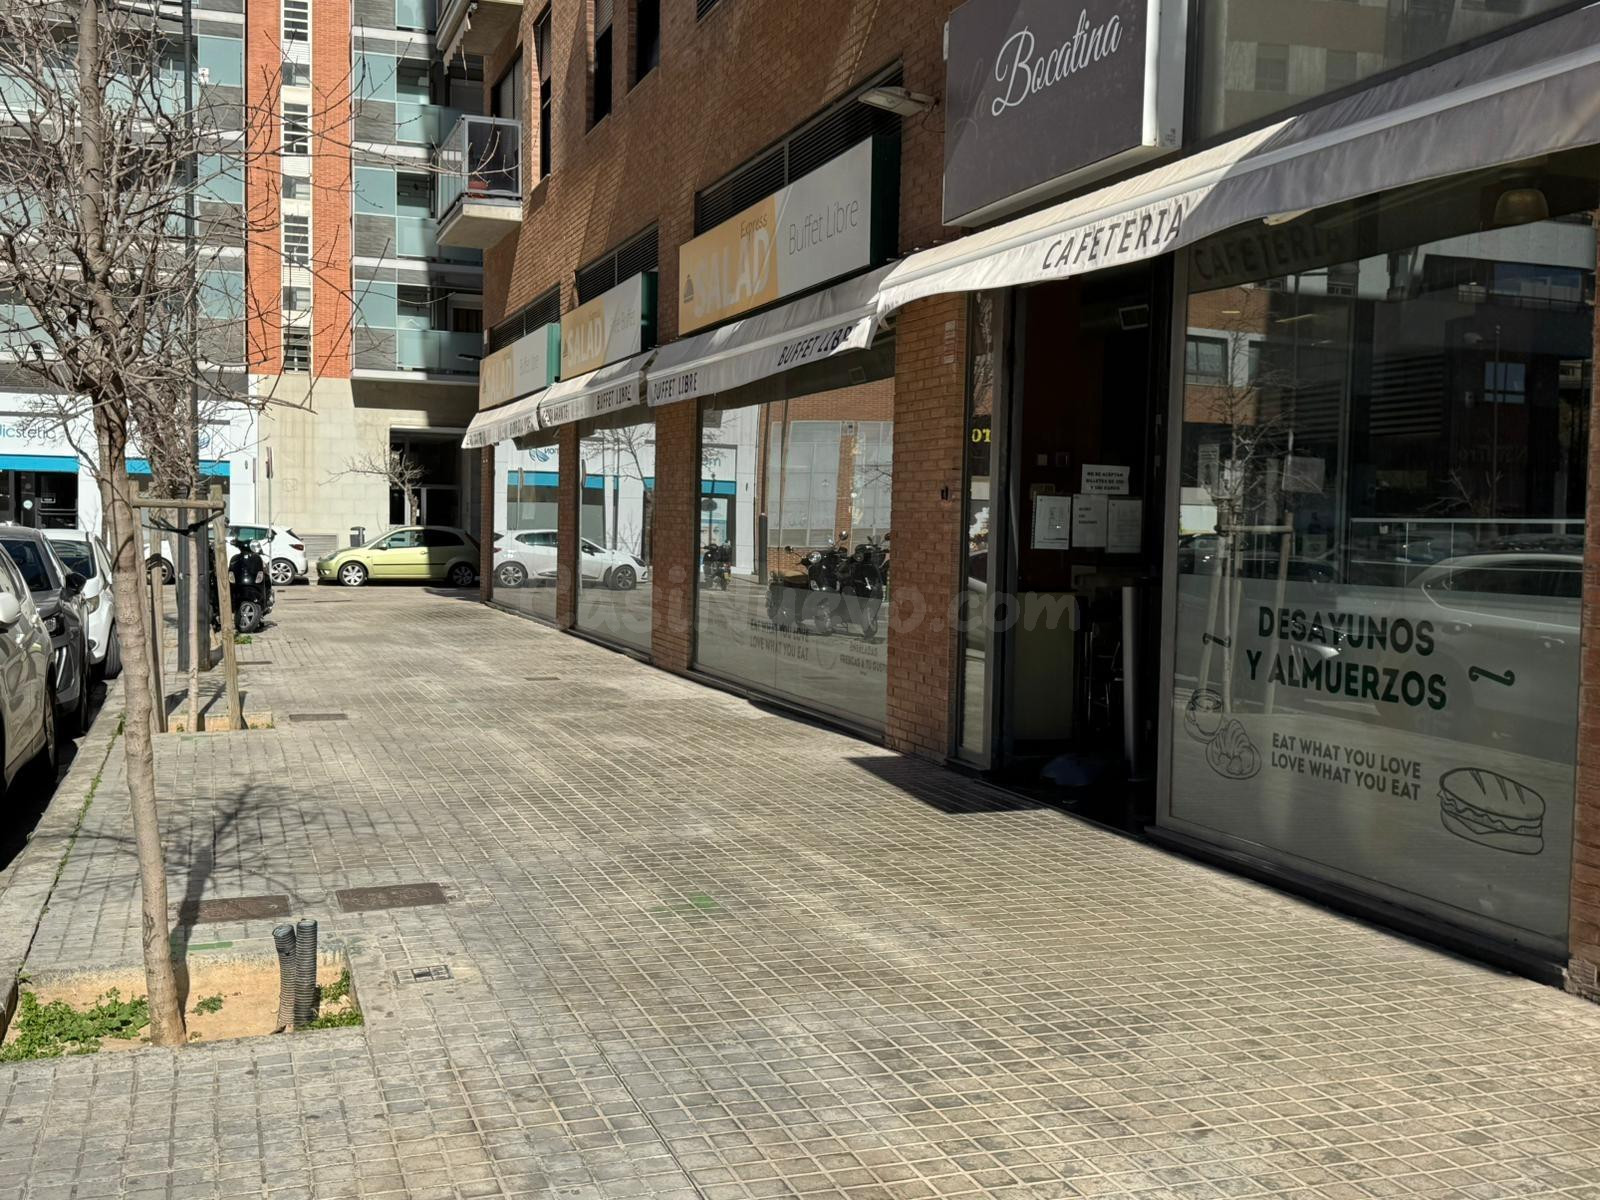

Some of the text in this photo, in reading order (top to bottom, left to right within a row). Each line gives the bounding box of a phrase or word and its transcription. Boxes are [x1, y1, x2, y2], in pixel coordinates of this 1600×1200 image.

[991, 8, 1123, 116] Bocatina
[740, 213, 768, 243] Express
[789, 200, 859, 256] Buffet Libre
[1042, 203, 1183, 270] CAFETERIA
[694, 230, 770, 318] SALAD
[567, 318, 604, 368] SALAD
[777, 336, 821, 367] BUFFET
[678, 372, 698, 396] LIBRE
[750, 635, 765, 650] LOVE
[783, 642, 796, 657] YOU
[797, 646, 809, 661] EAT
[1258, 606, 1434, 655] DESAYUNOS
[1246, 649, 1447, 710] Y ALMUERZOS
[1271, 751, 1422, 801] LOVE WHAT YOU EAT
[1272, 732, 1422, 781] EAT WHAT YOU LOVE
